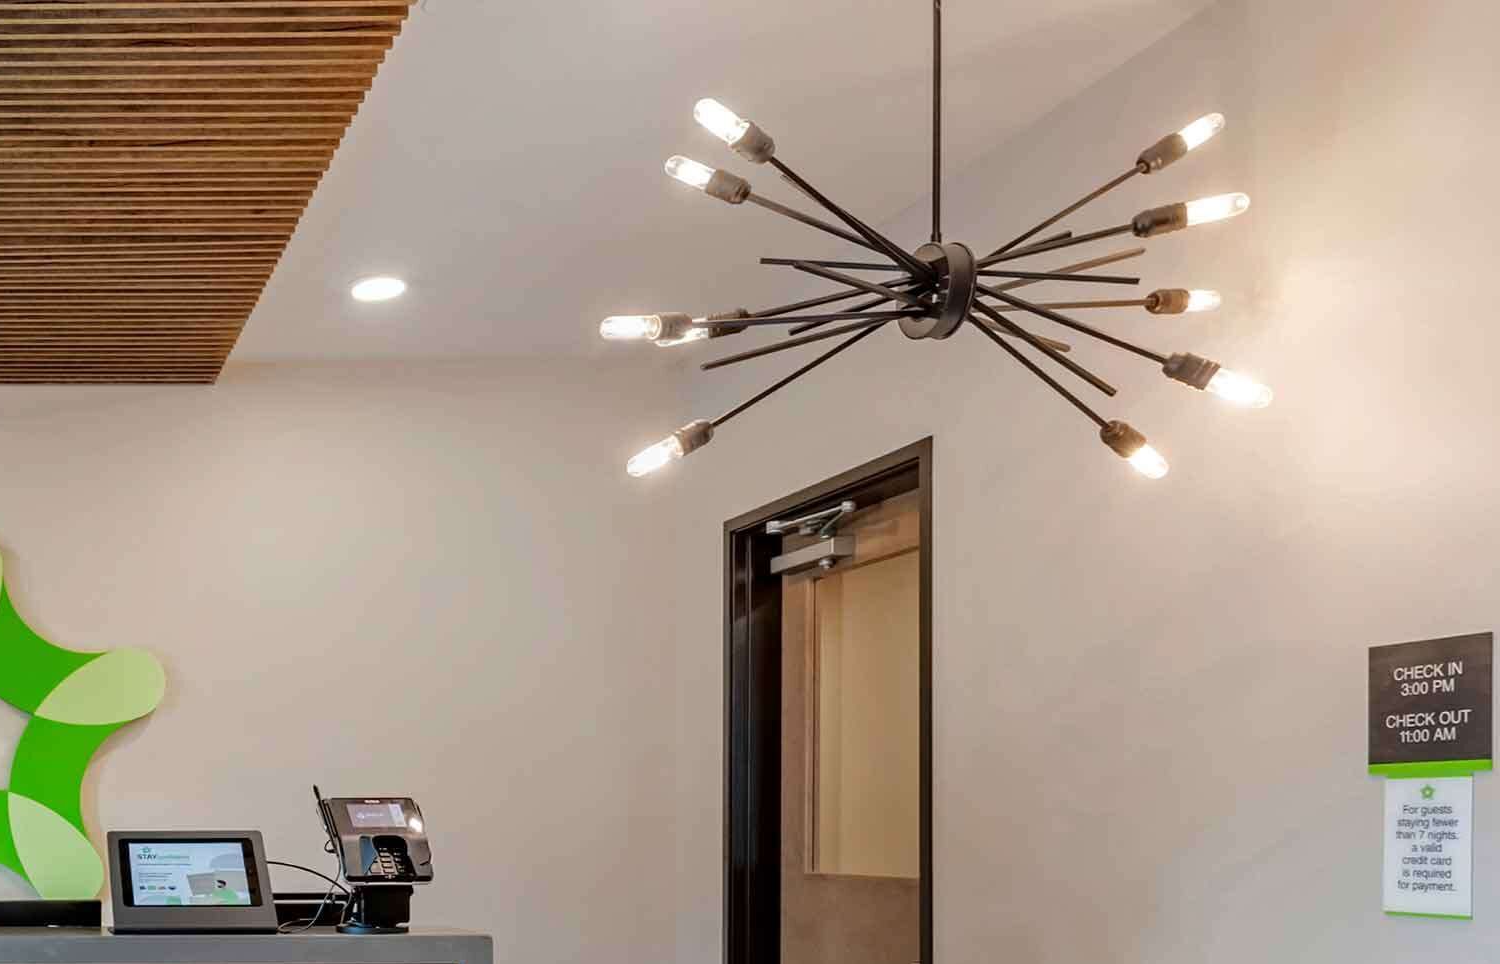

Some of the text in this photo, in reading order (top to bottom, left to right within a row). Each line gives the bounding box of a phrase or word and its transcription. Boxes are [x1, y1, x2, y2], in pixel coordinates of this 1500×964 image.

[1393, 661, 1463, 681] CHECK IN
[1400, 678, 1455, 696] 3:00 PM
[1385, 708, 1472, 729] CHECK OUT
[1399, 726, 1456, 743] 11:00 AM
[1403, 804, 1452, 816] For guests
[1397, 817, 1459, 829] staying fewer
[1396, 830, 1416, 839] than
[1419, 830, 1425, 839] 7
[1411, 844, 1418, 852] a
[1402, 856, 1452, 866] credit card
[1412, 869, 1452, 880] required
[1397, 879, 1410, 889] for
